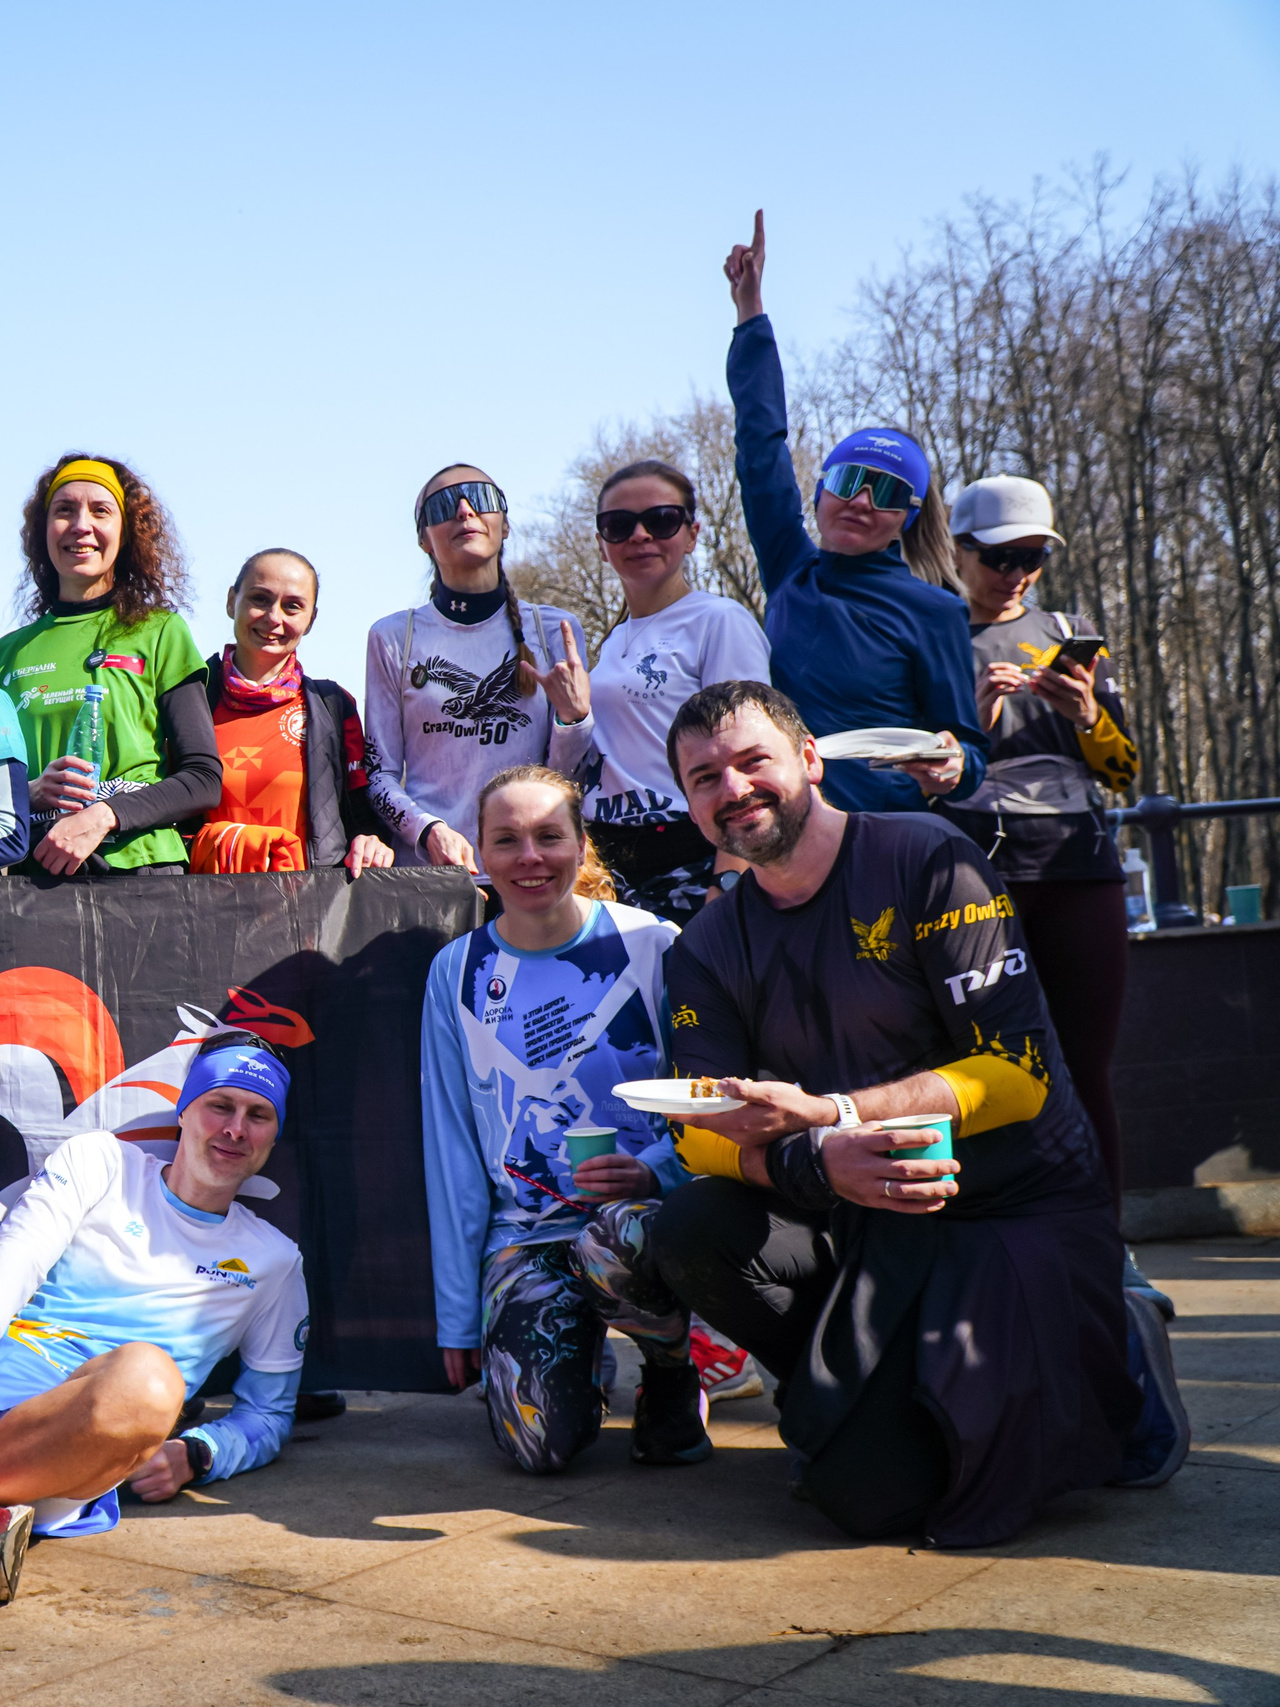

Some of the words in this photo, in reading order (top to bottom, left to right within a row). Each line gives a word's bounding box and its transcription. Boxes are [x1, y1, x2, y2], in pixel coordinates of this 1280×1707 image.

[42, 687, 74, 700] ЗЕЛЕНЫЙ
[44, 695, 74, 706] БЕГУЩИЕ
[285, 703, 306, 715] GOLD
[422, 721, 455, 734] Crazy
[454, 722, 480, 738] Owl
[479, 721, 510, 746] 50
[594, 788, 673, 823] MAD
[964, 899, 997, 925] Owl
[484, 1006, 513, 1018] ДОРОГА
[484, 1013, 514, 1025] ЖИЗНИ
